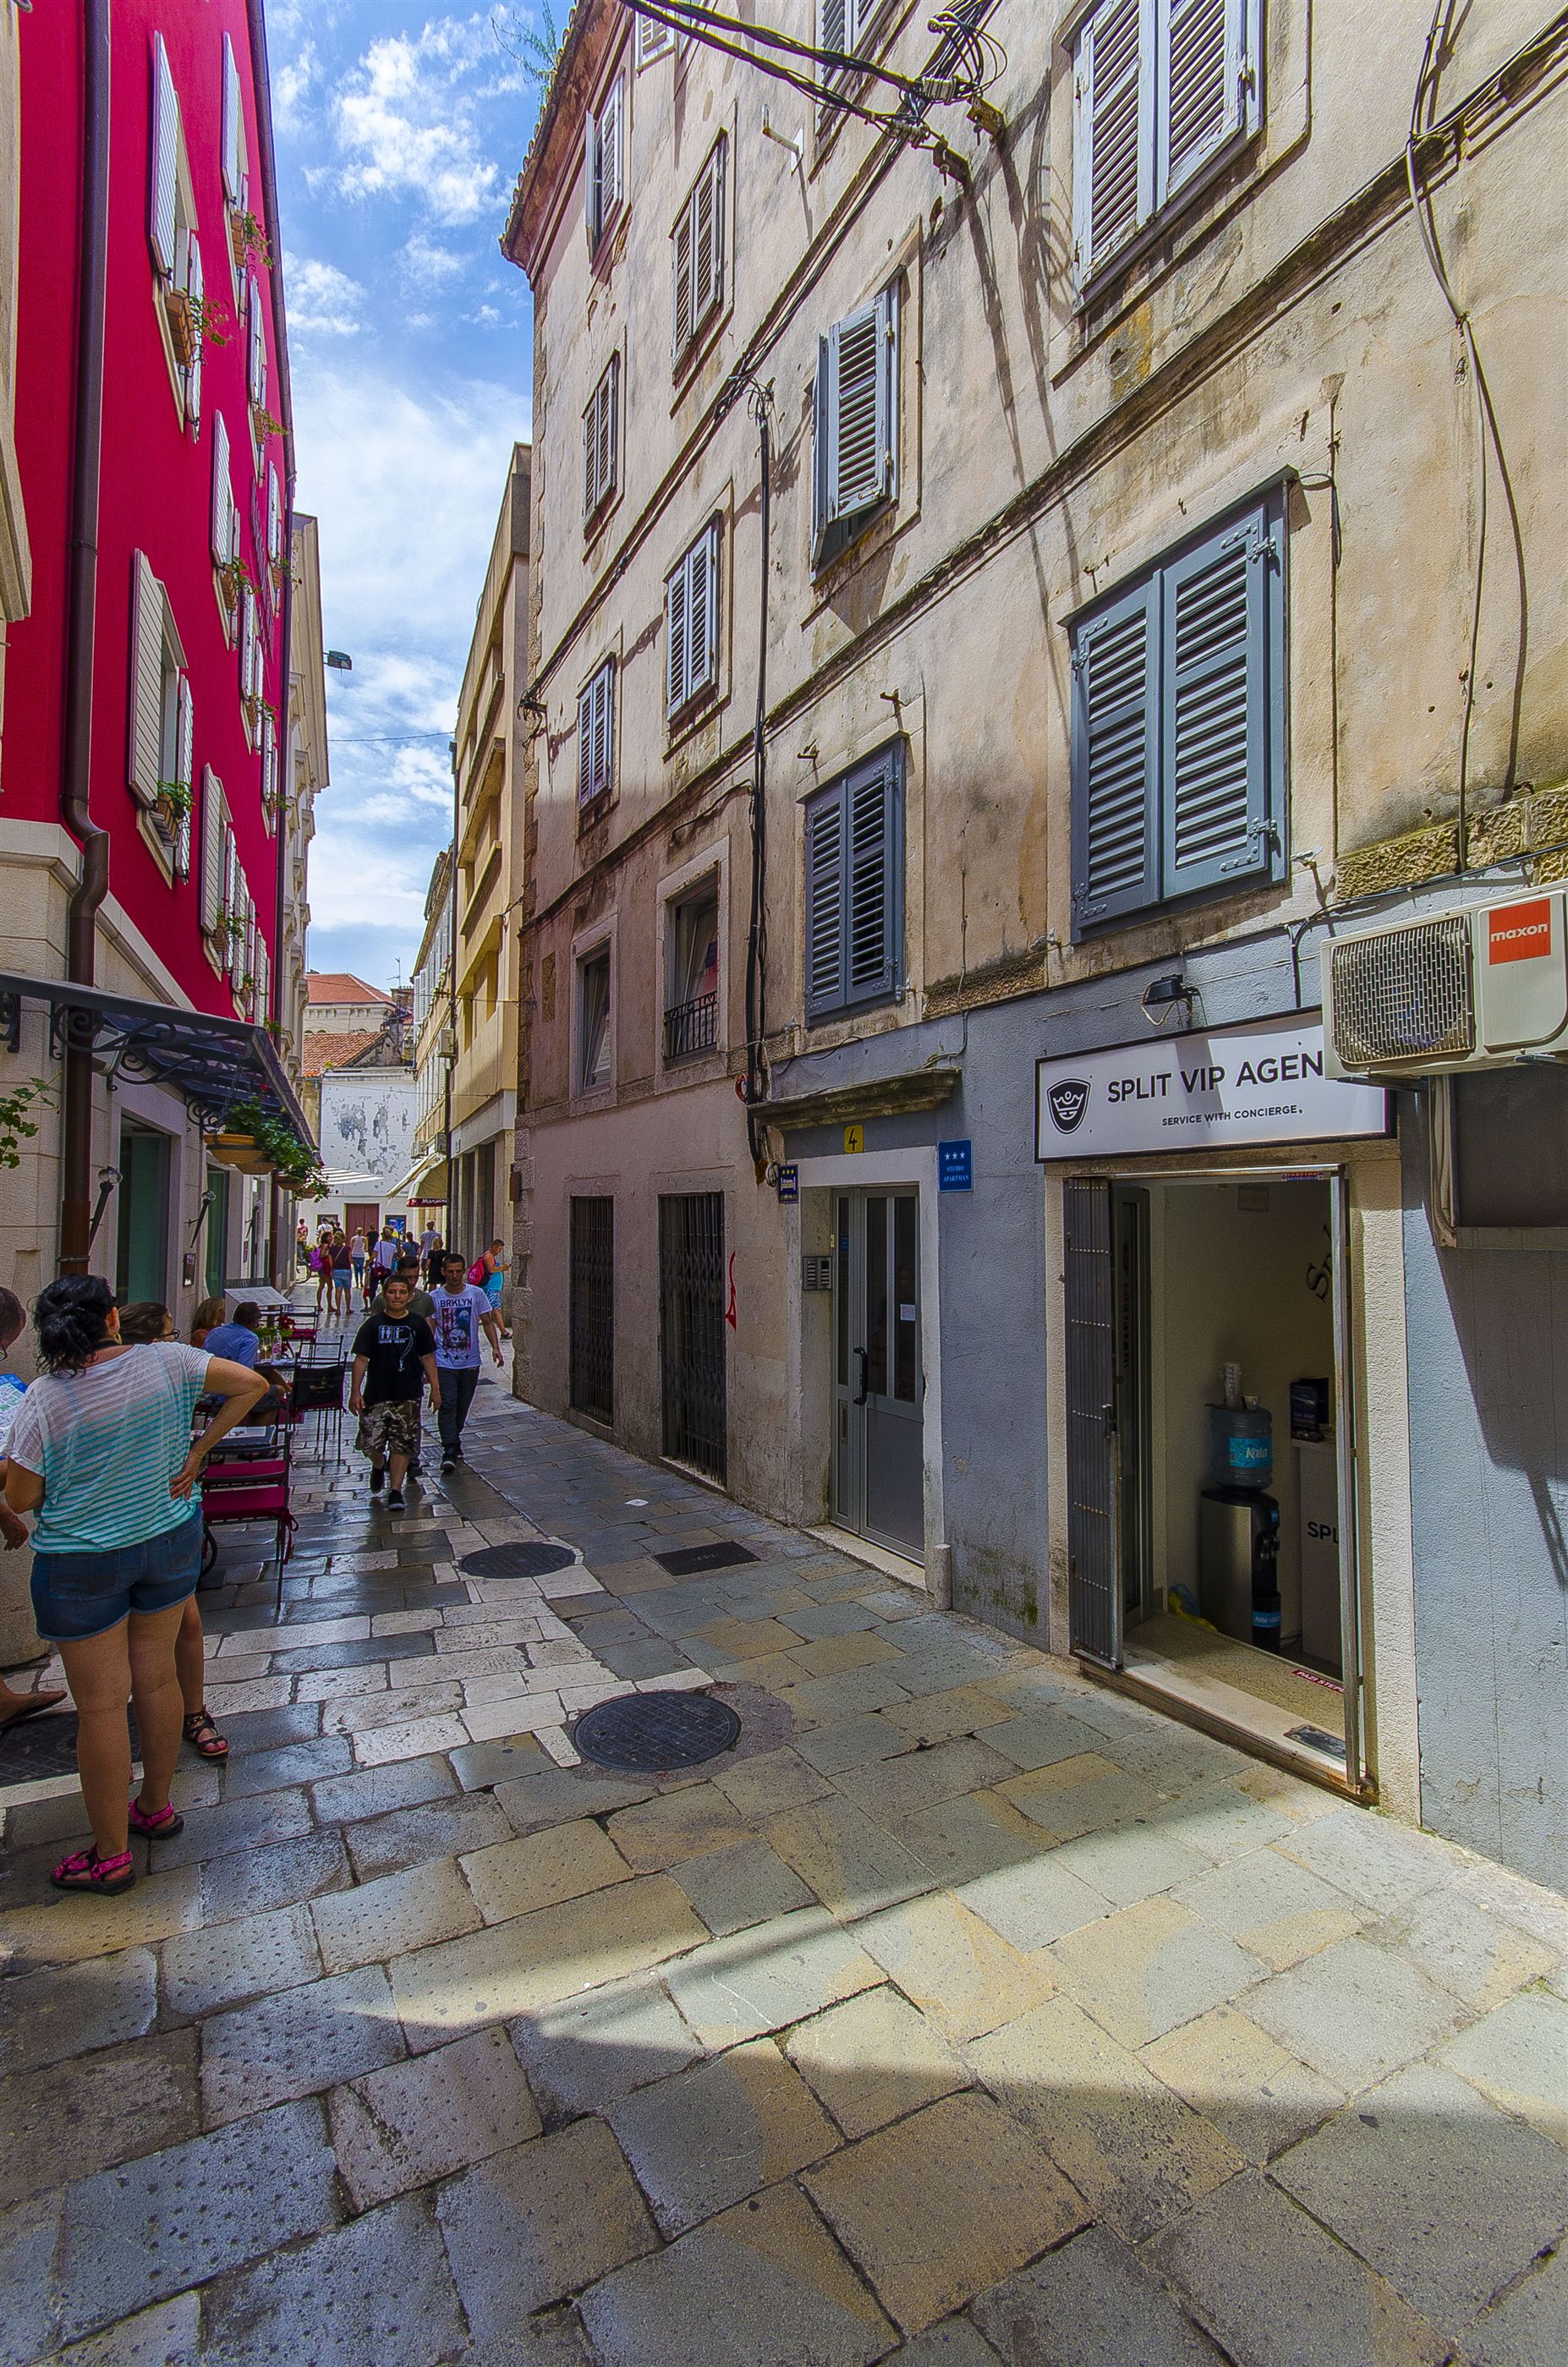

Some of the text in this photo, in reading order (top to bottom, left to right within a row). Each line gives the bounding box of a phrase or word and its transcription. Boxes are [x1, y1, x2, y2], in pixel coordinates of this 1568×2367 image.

[1490, 923, 1549, 943] maxon
[1106, 1072, 1172, 1104] SPLIT
[1180, 1065, 1226, 1094] VIP
[1161, 1104, 1297, 1127] SERVICE WITH CONCIERGE
[848, 1128, 858, 1151] 4
[440, 1298, 473, 1308] BRKLYN
[1297, 1671, 1319, 1681] PAZI
